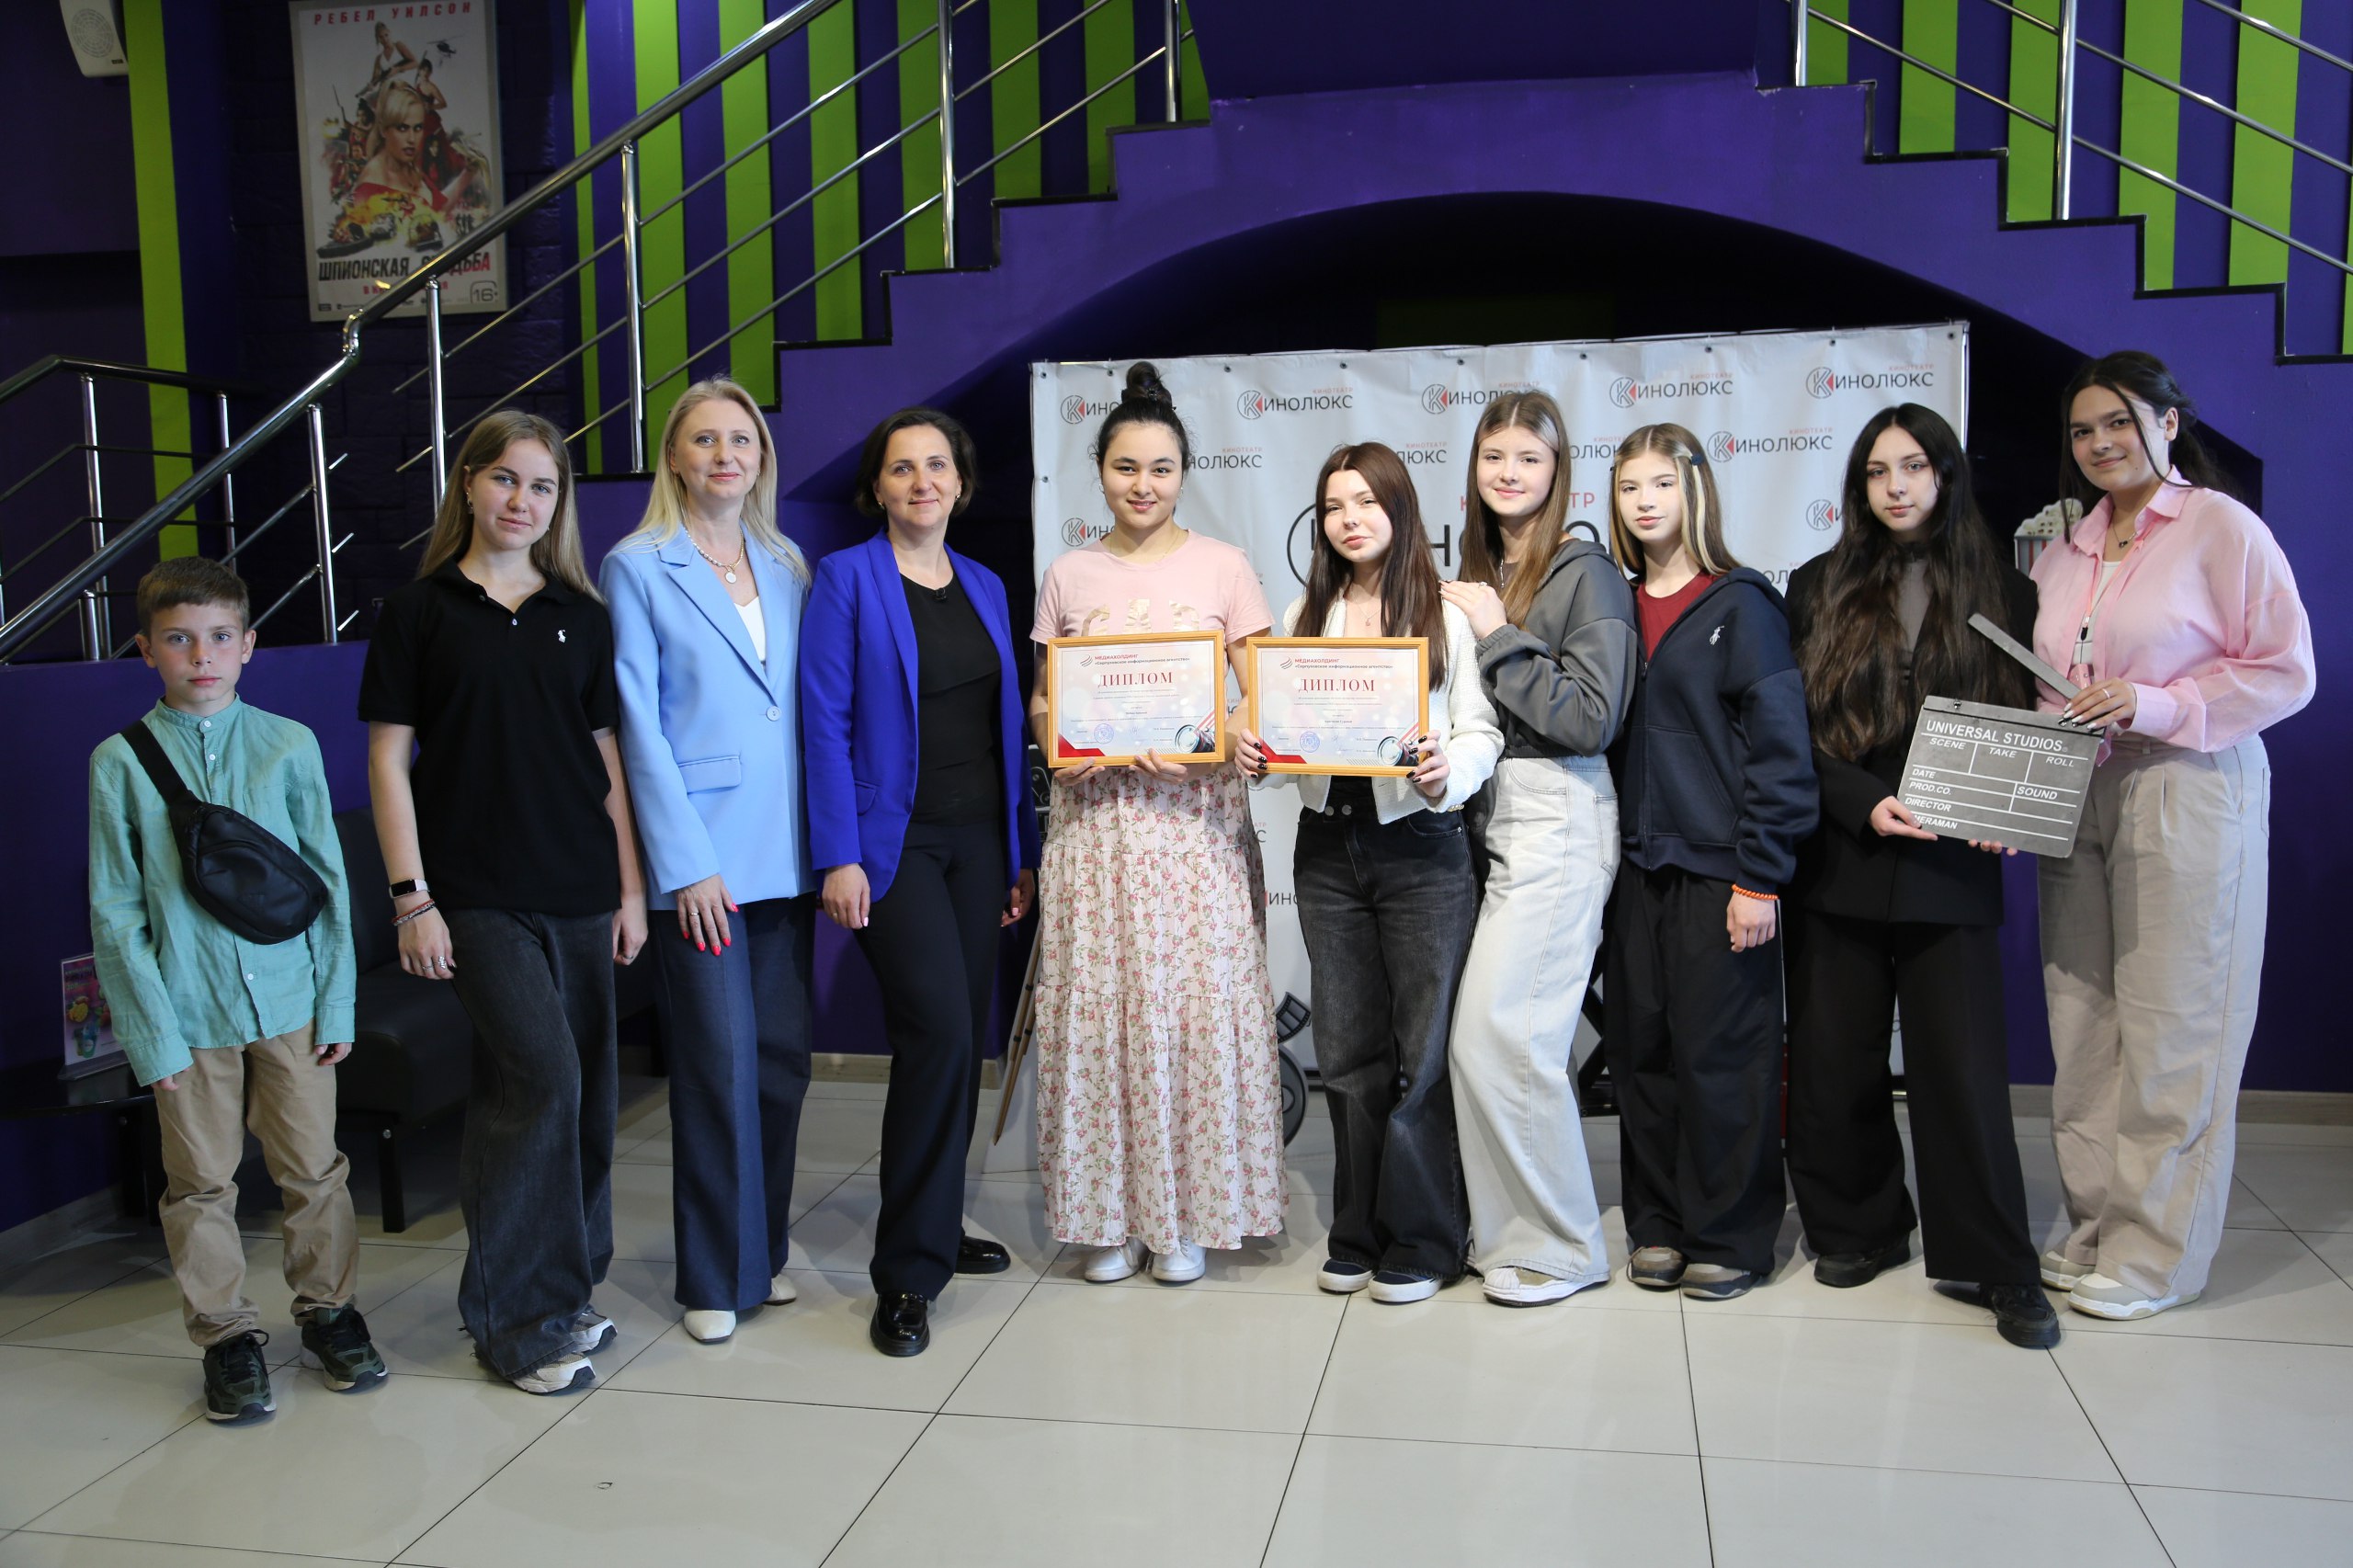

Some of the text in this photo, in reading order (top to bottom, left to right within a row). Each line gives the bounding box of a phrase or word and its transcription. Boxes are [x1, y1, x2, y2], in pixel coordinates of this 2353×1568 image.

[314, 2, 471, 25] РЕБЕЛ УИЛСОН
[319, 256, 410, 281] ШПИОНСКАЯ
[1097, 672, 1173, 688] ДИПЛОМ
[1299, 678, 1375, 694] ДИПЛОМ
[1926, 721, 2063, 752] UNIVERSAL STUDIOS
[1929, 737, 2075, 767] SCENE TAKE ROLL
[1912, 768, 1936, 778] DATE
[2017, 786, 2058, 801] SOUND
[1904, 797, 1952, 812] DIRECTOR
